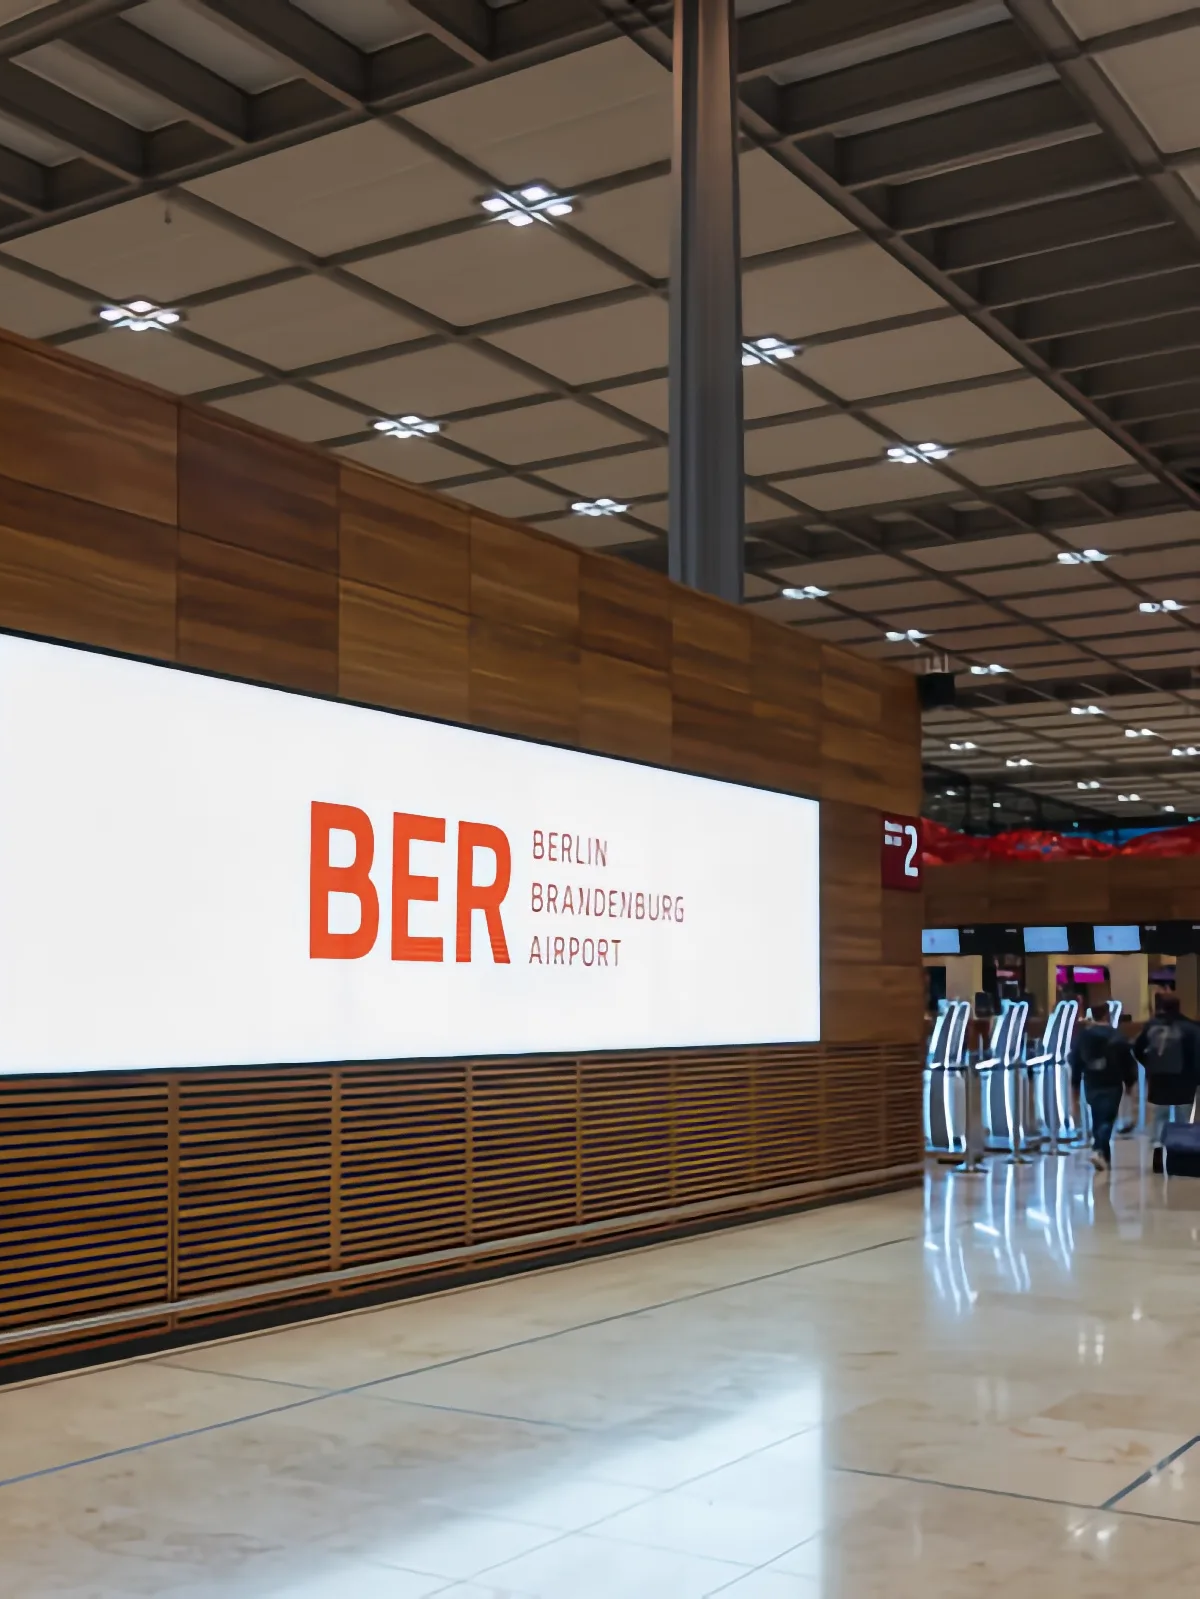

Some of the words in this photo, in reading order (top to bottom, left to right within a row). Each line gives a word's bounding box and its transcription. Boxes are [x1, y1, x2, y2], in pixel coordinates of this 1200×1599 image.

[532, 829, 608, 867] BERLIN
[904, 825, 919, 877] 2
[309, 800, 511, 964] BER
[531, 882, 684, 923] BRANDENBURG
[528, 935, 622, 968] AIRPORT
